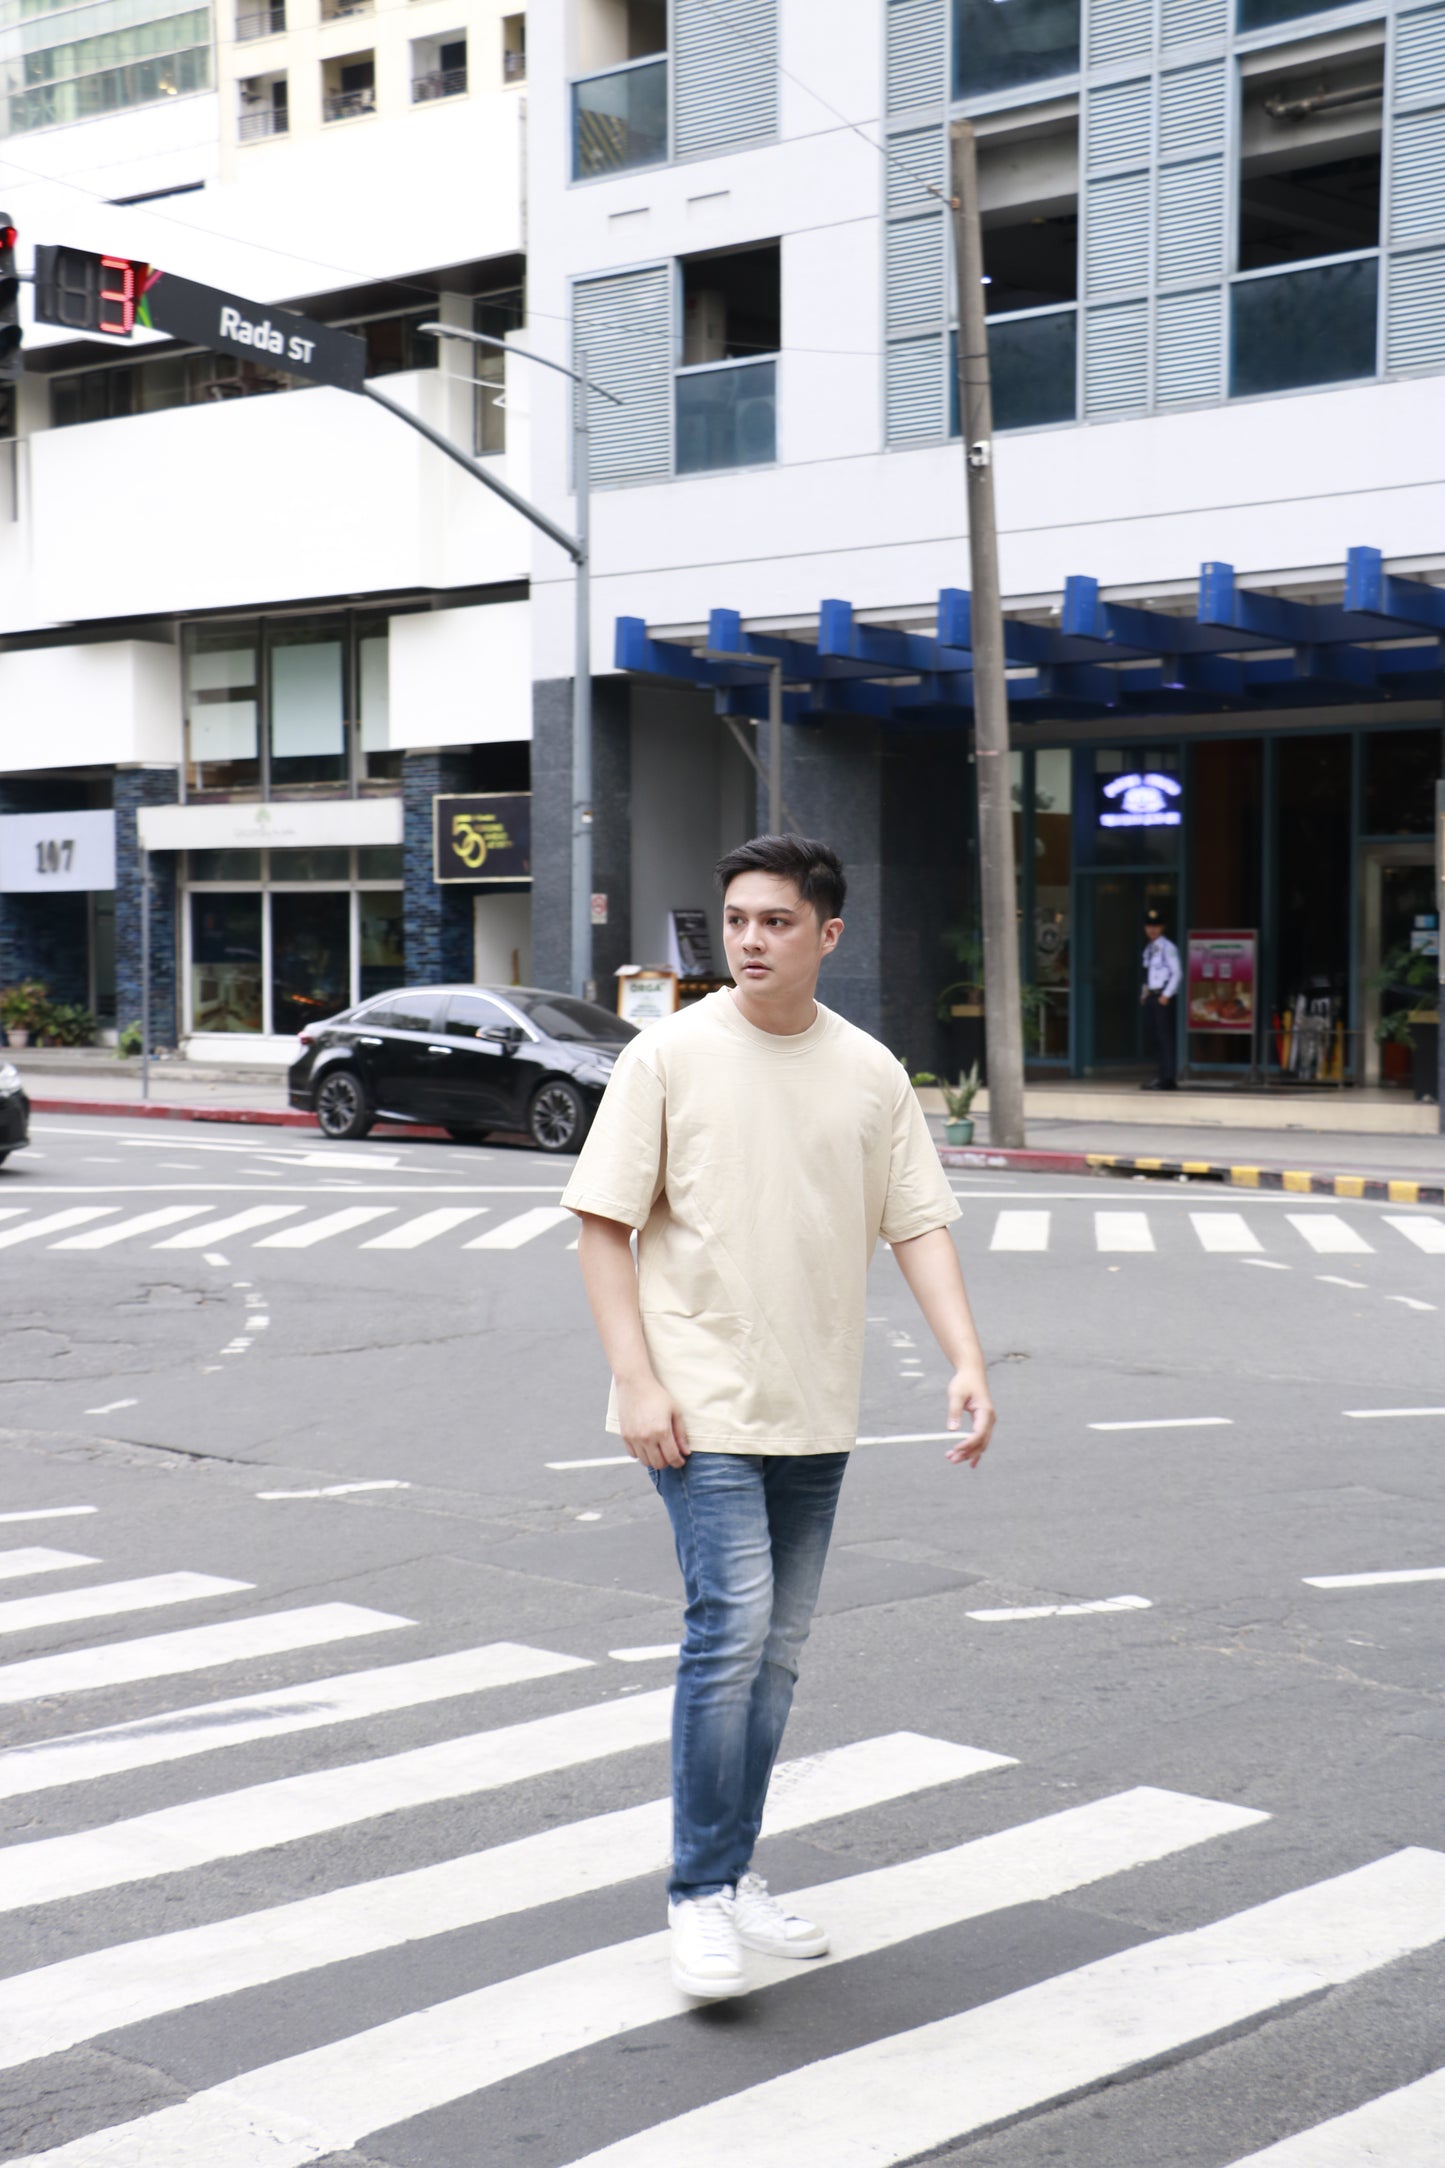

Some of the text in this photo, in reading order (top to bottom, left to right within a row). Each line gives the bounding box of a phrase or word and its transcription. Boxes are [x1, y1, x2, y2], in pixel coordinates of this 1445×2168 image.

[100, 255, 136, 335] 3
[219, 305, 316, 364] Rada ST
[35, 838, 76, 874] 107
